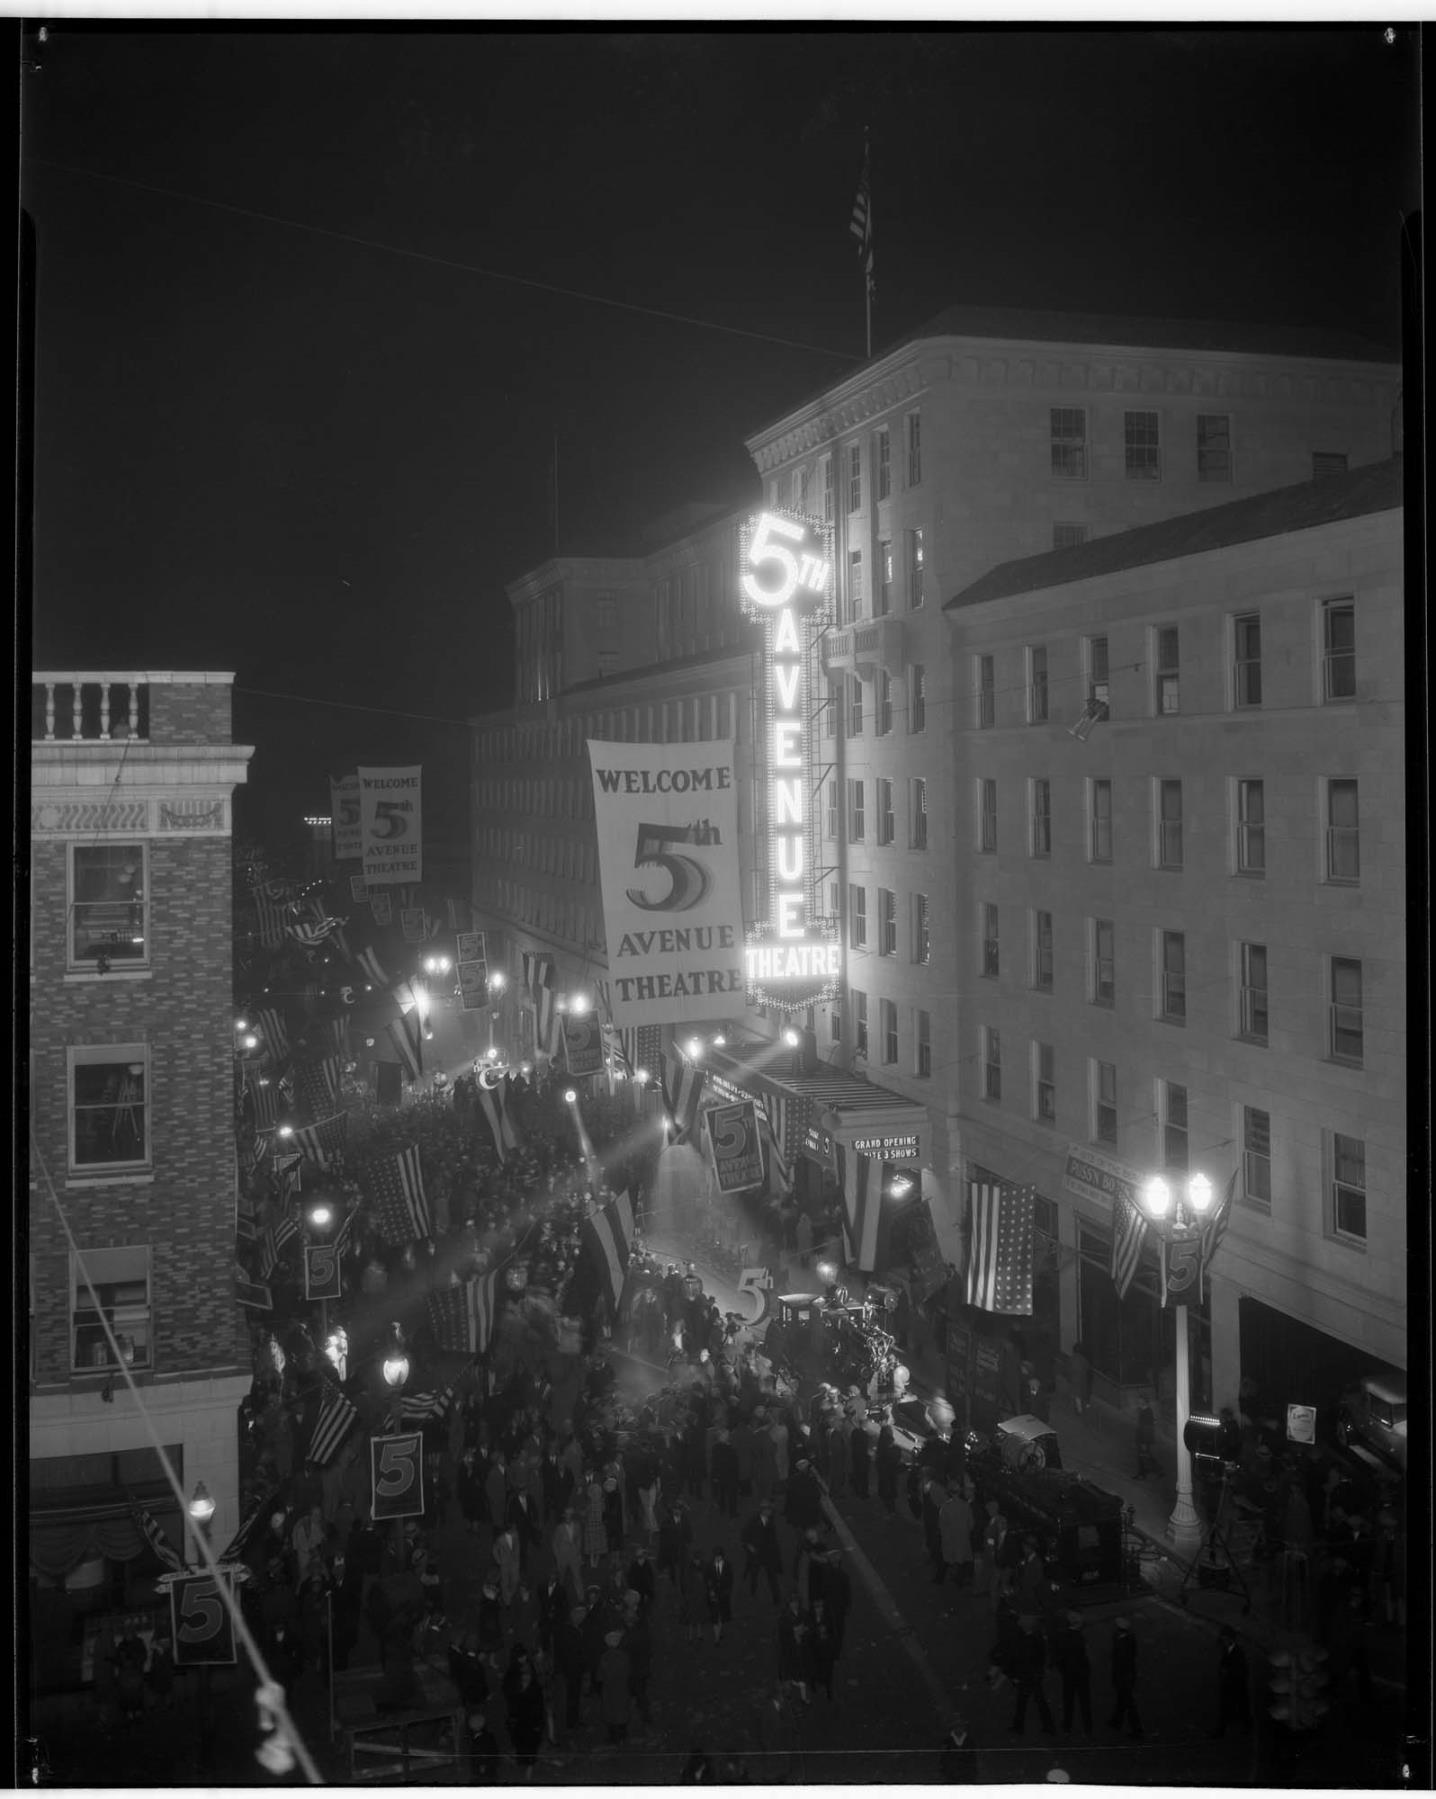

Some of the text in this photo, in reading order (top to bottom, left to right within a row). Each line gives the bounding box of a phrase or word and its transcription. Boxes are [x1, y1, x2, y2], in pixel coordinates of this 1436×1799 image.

[742, 512, 830, 606] 5TH
[363, 777, 419, 790] WELCOME
[596, 766, 731, 794] WELCOME
[774, 608, 804, 938] AVENUE
[369, 799, 414, 839] 5th
[365, 843, 418, 857] AVENUE
[626, 818, 723, 913] 5th
[364, 861, 417, 875] THEATRE
[617, 925, 735, 957] AVENUE
[746, 946, 840, 978] THEATRE
[616, 968, 743, 1002] THEATRE
[855, 1136, 917, 1150] GRAND OPENING
[890, 1147, 917, 1159] SHOWS
[311, 1249, 335, 1286] 5
[1168, 1240, 1200, 1292] 5
[376, 1438, 417, 1496] 5
[177, 1580, 224, 1643] 5
